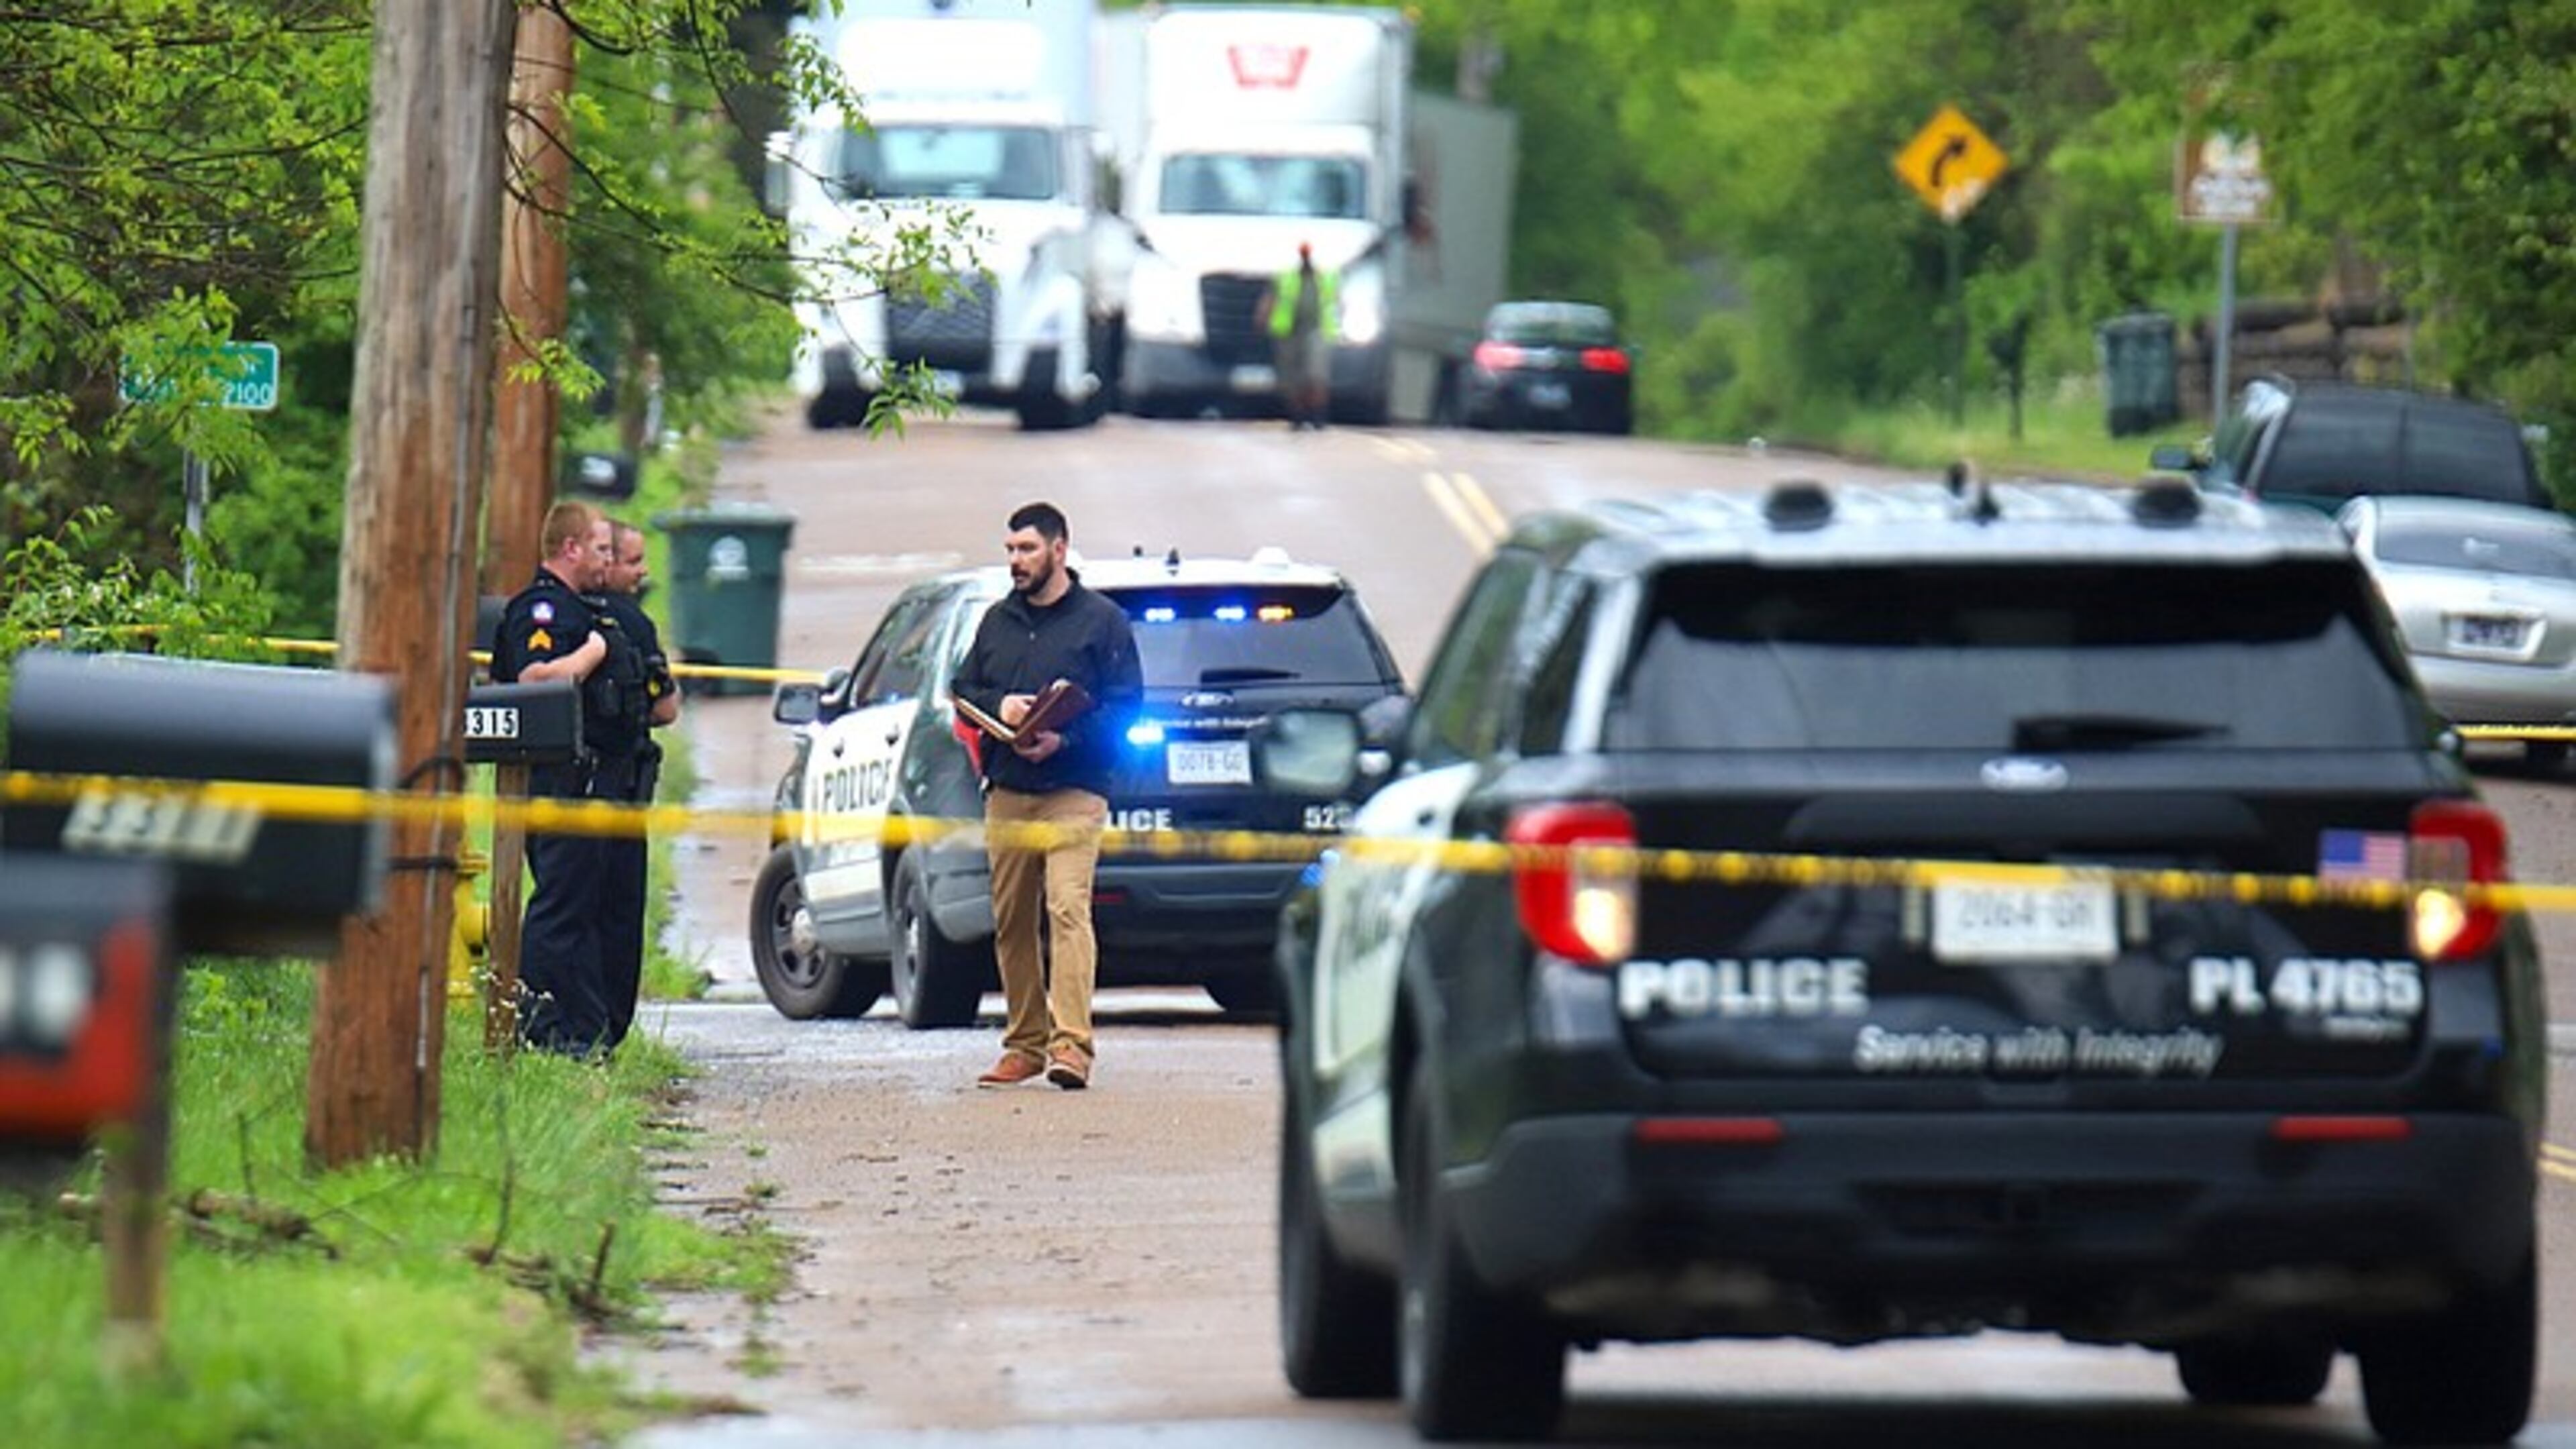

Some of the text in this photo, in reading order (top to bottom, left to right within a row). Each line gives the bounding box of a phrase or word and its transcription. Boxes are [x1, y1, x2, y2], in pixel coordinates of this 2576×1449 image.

[823, 757, 893, 814] POLICE
[1104, 808, 1174, 832] LICE
[1618, 958, 1872, 1018] POLICE
[2188, 957, 2424, 1014] PL 4765
[1853, 1024, 2226, 1077] Service with Integrity
